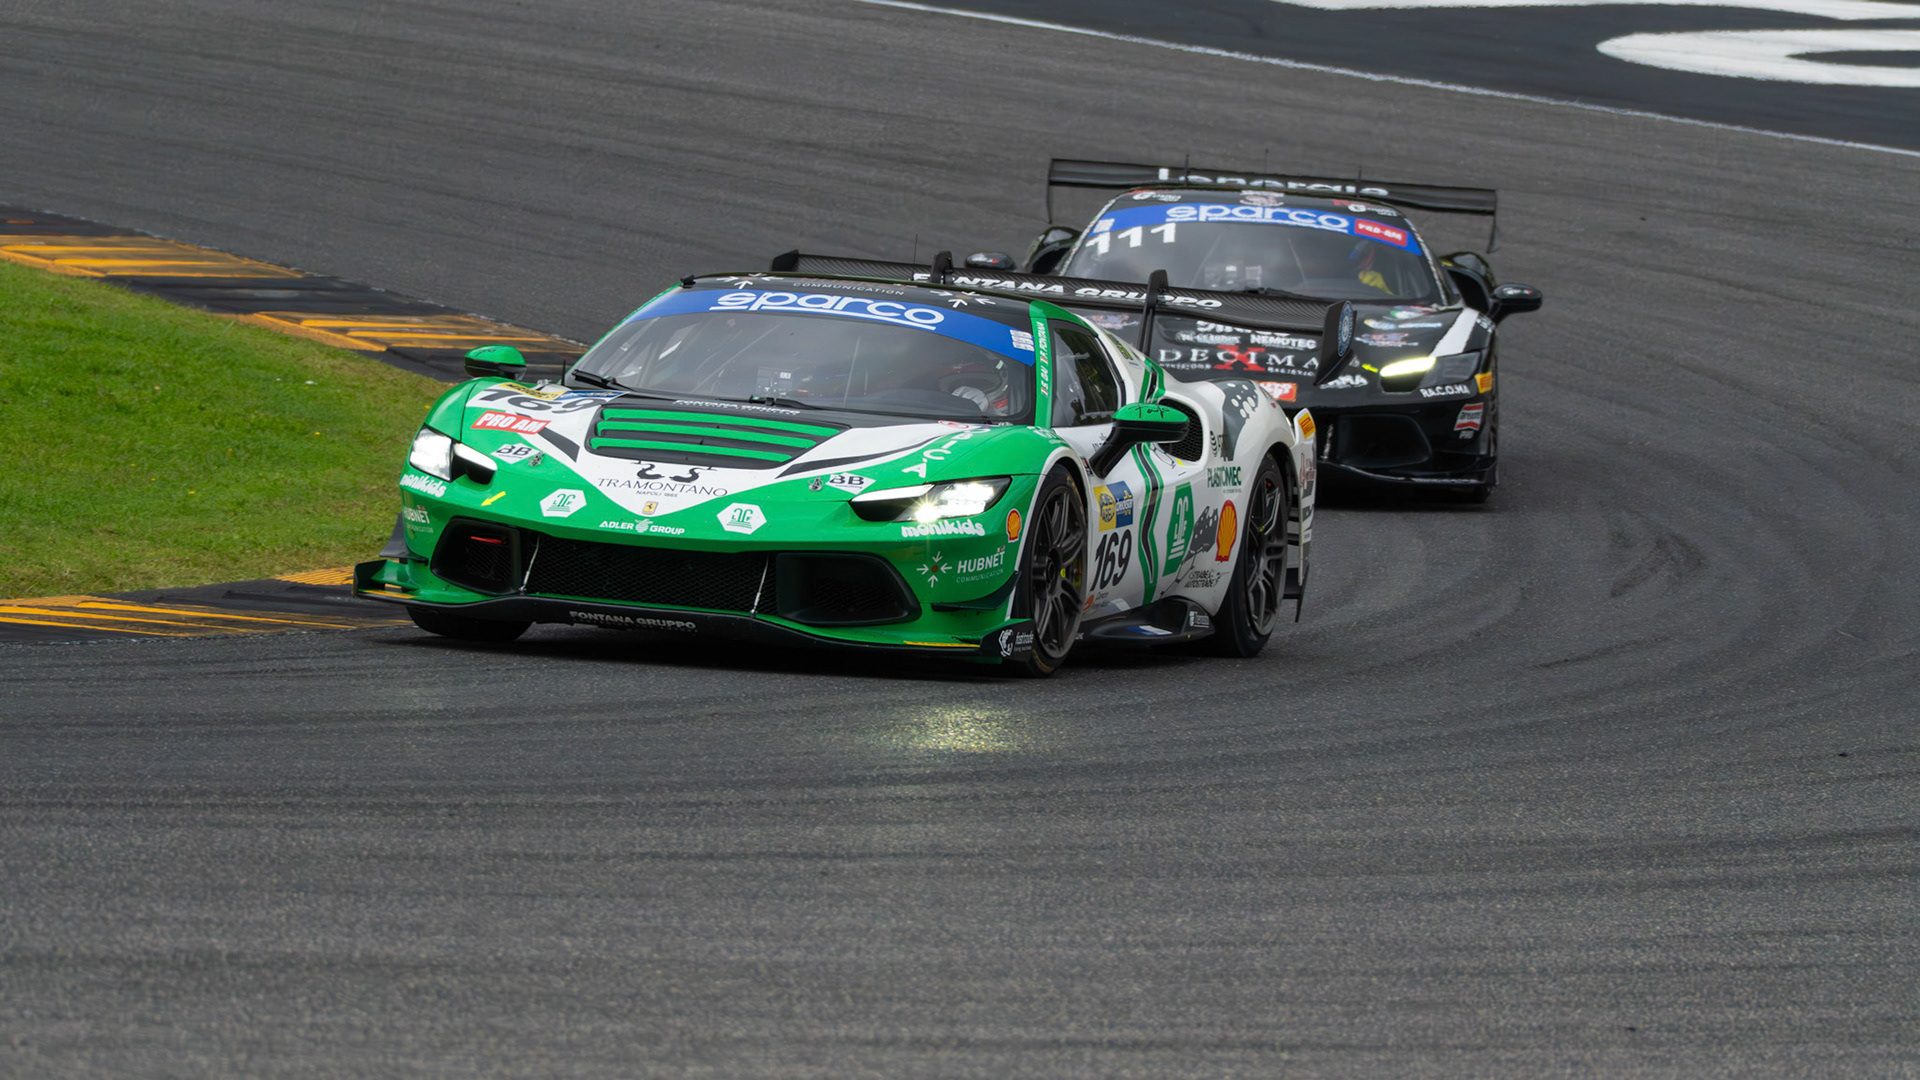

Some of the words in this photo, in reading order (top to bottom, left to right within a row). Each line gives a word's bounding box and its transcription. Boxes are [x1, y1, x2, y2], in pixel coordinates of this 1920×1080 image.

[1166, 204, 1349, 229] sparco
[1085, 222, 1176, 255] 111
[793, 282, 904, 296] COMMUNICATION
[912, 273, 1064, 293] FNTANA
[717, 292, 945, 325] sparco
[478, 389, 607, 413] 169
[475, 412, 513, 428] PRO
[512, 418, 546, 432] AM
[496, 445, 533, 456] BB
[597, 478, 728, 497] TRAMONTANO
[829, 475, 864, 485] BB
[599, 520, 634, 530] ADLER
[649, 525, 685, 535] GROUP
[901, 519, 985, 538] monikids
[957, 551, 1005, 573] HUBNET
[1090, 529, 1132, 592] 169
[569, 611, 634, 624] FONTANA
[636, 617, 696, 629] GRUPPO
